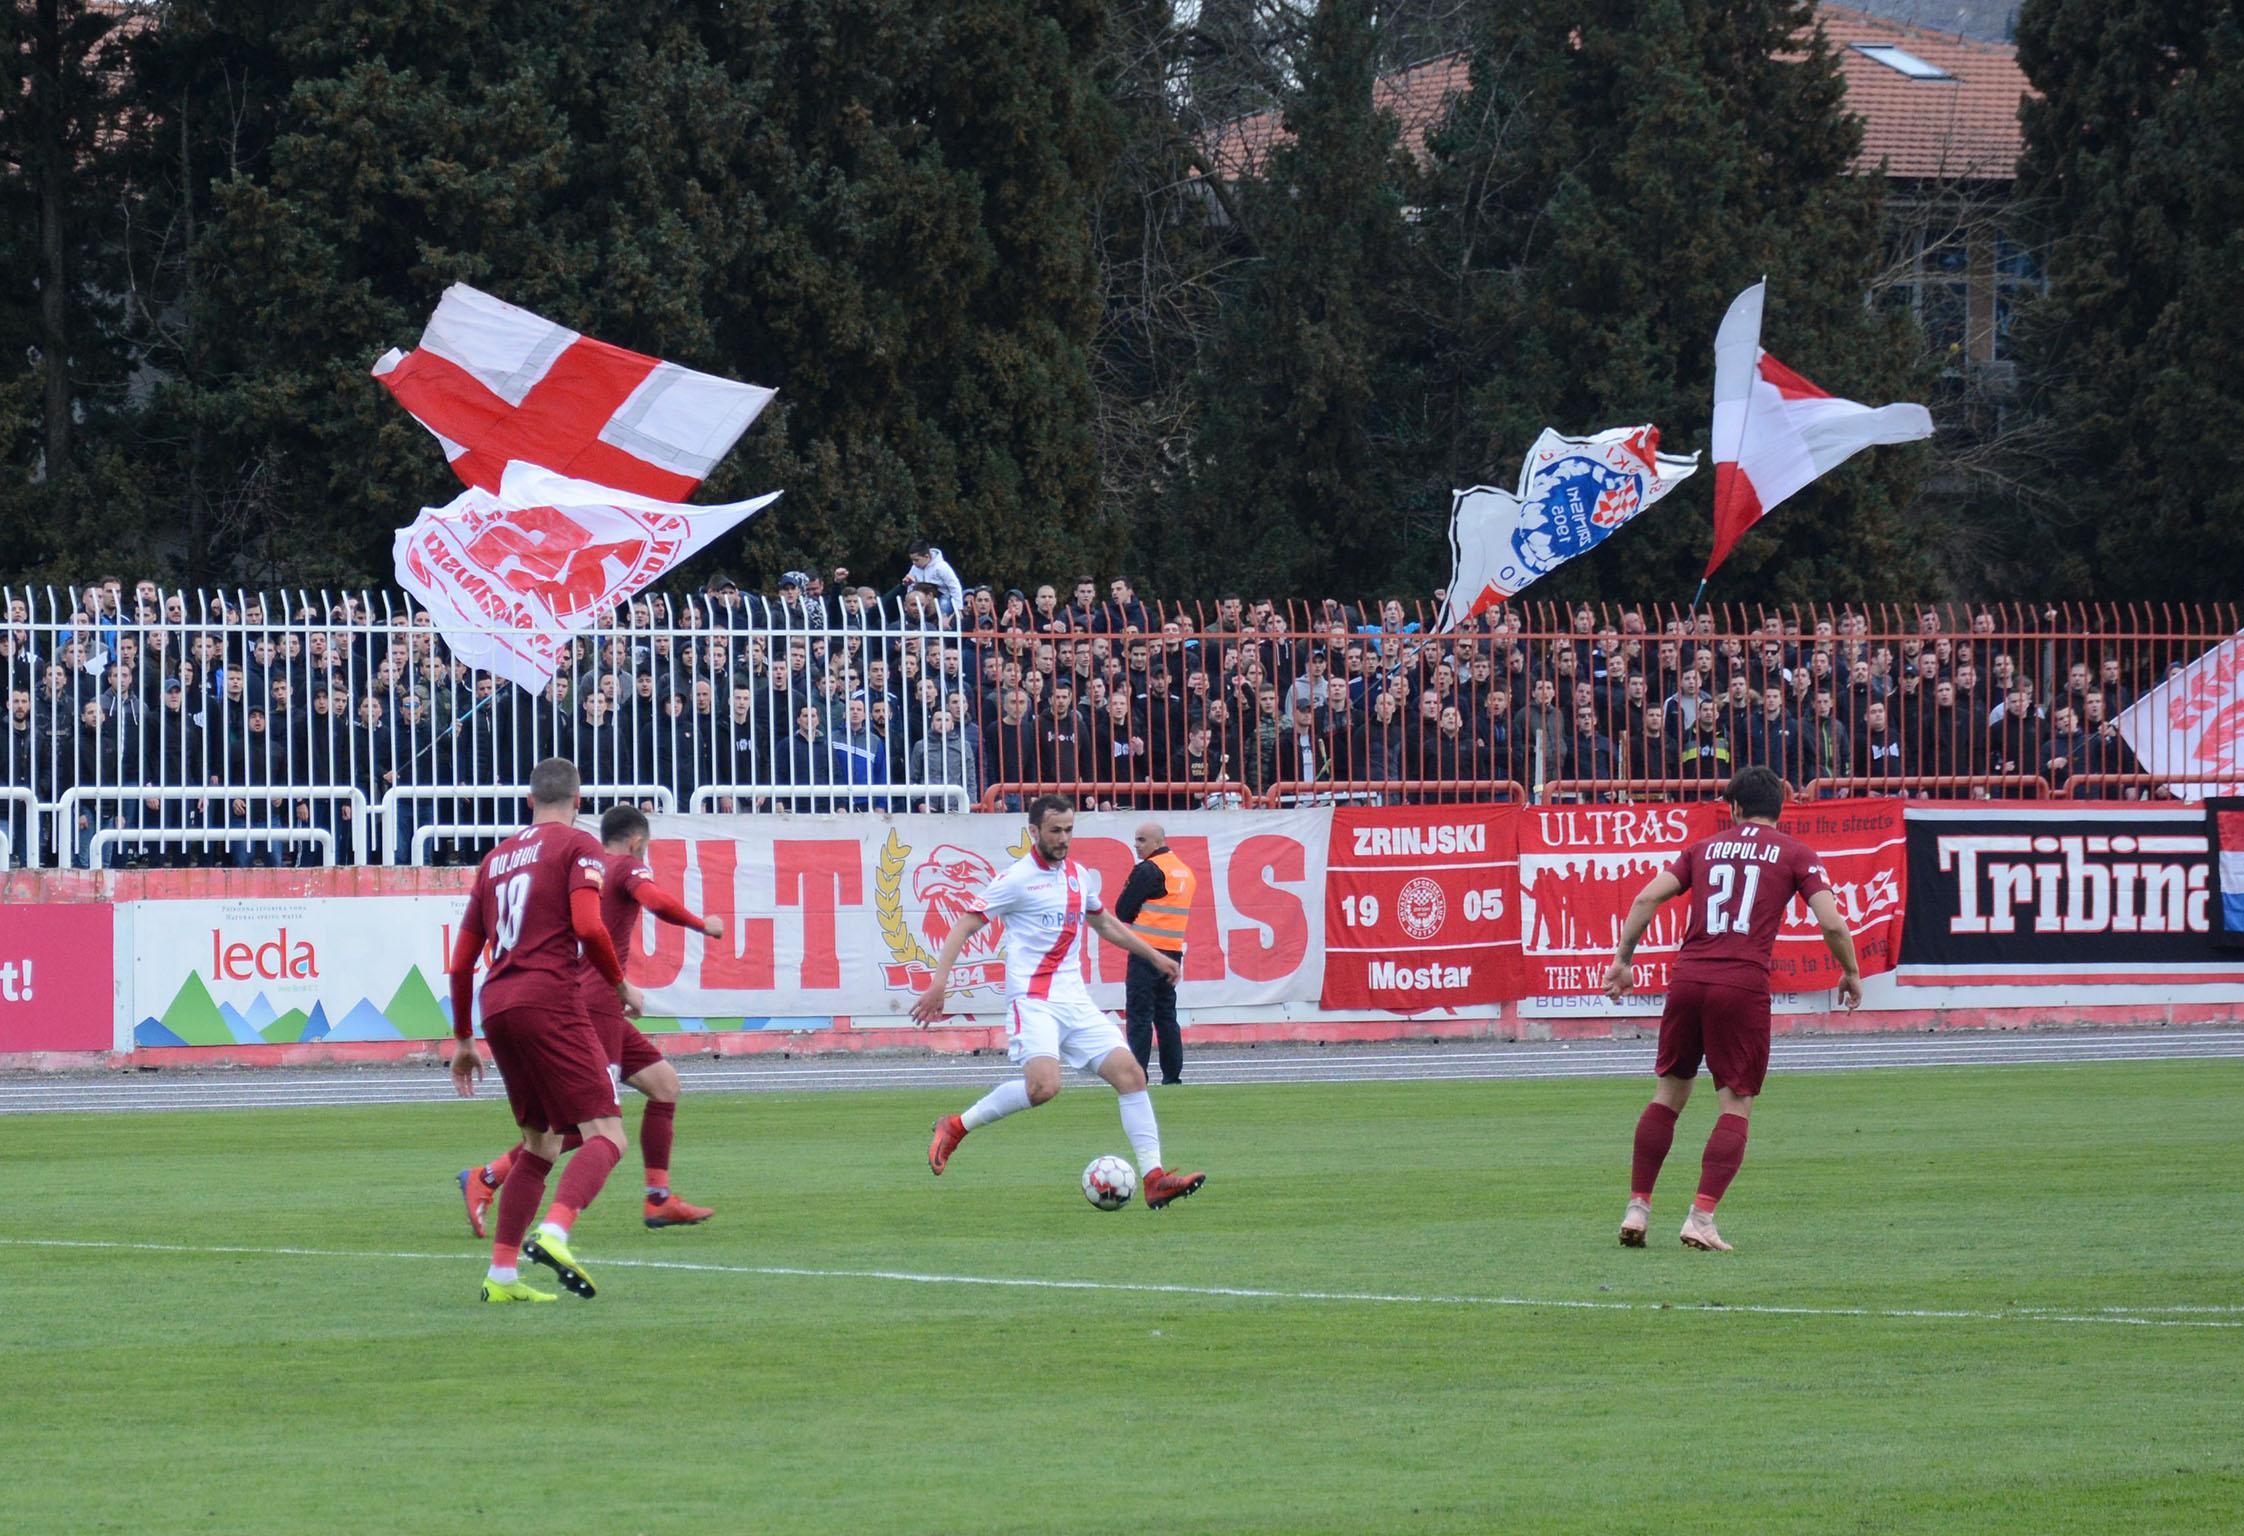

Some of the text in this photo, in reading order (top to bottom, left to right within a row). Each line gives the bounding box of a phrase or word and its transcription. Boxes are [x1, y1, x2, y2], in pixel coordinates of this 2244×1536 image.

[1353, 824, 1486, 856] ZRINJSKI
[1538, 809, 1688, 848] ULTRAS
[495, 872, 532, 959] 18
[1342, 888, 1504, 927] 19 05
[1707, 864, 1761, 935] 21
[211, 927, 320, 981] leda
[1370, 961, 1471, 990] Mostar
[1545, 964, 1581, 990] THE
